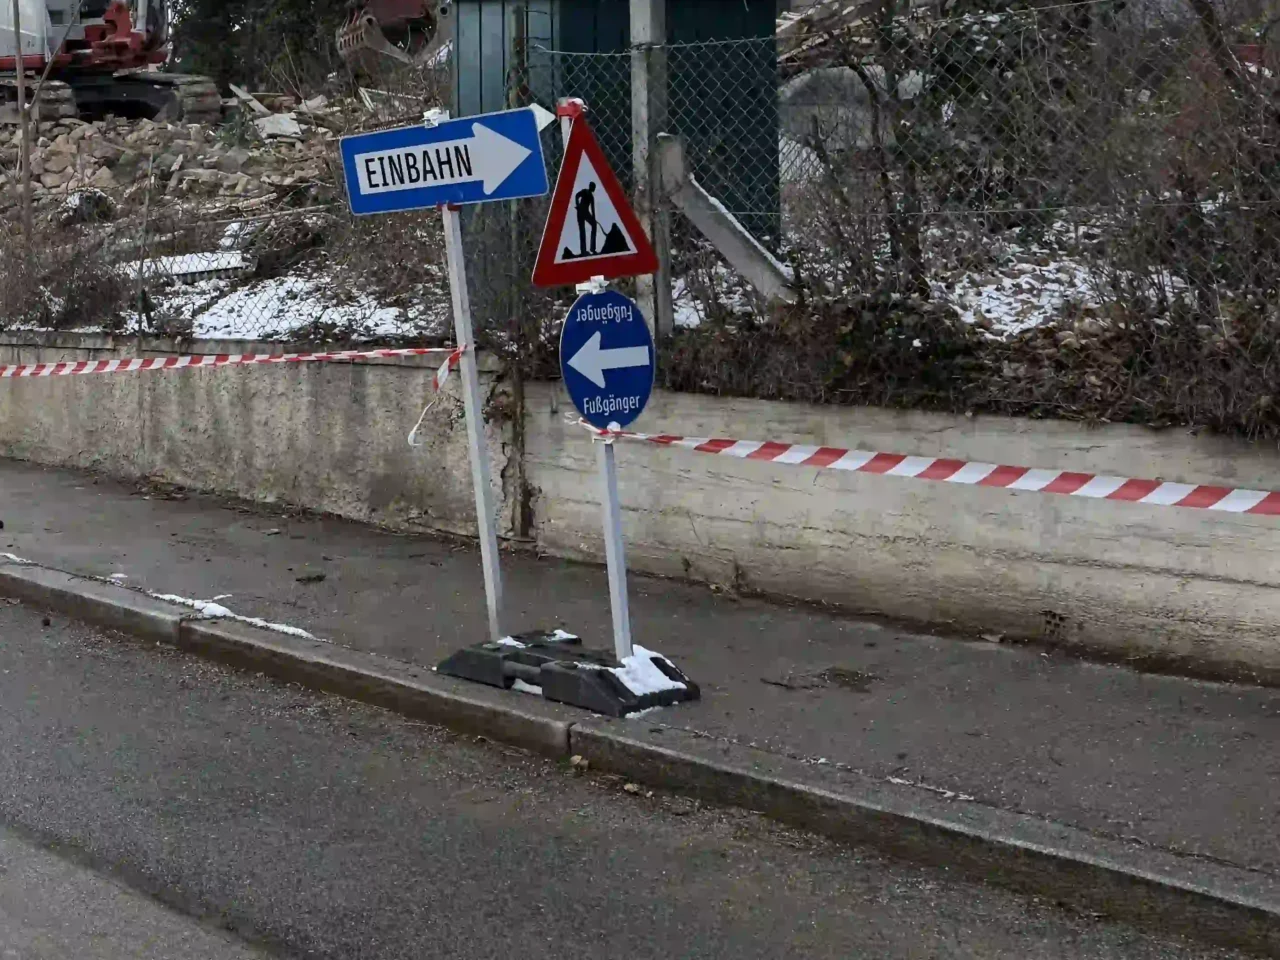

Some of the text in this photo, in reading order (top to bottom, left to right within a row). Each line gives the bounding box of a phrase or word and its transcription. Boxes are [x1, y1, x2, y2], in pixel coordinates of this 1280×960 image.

[364, 144, 473, 189] EINBAHN
[576, 303, 633, 325] Fußgänger
[583, 393, 640, 416] Fußgänger
